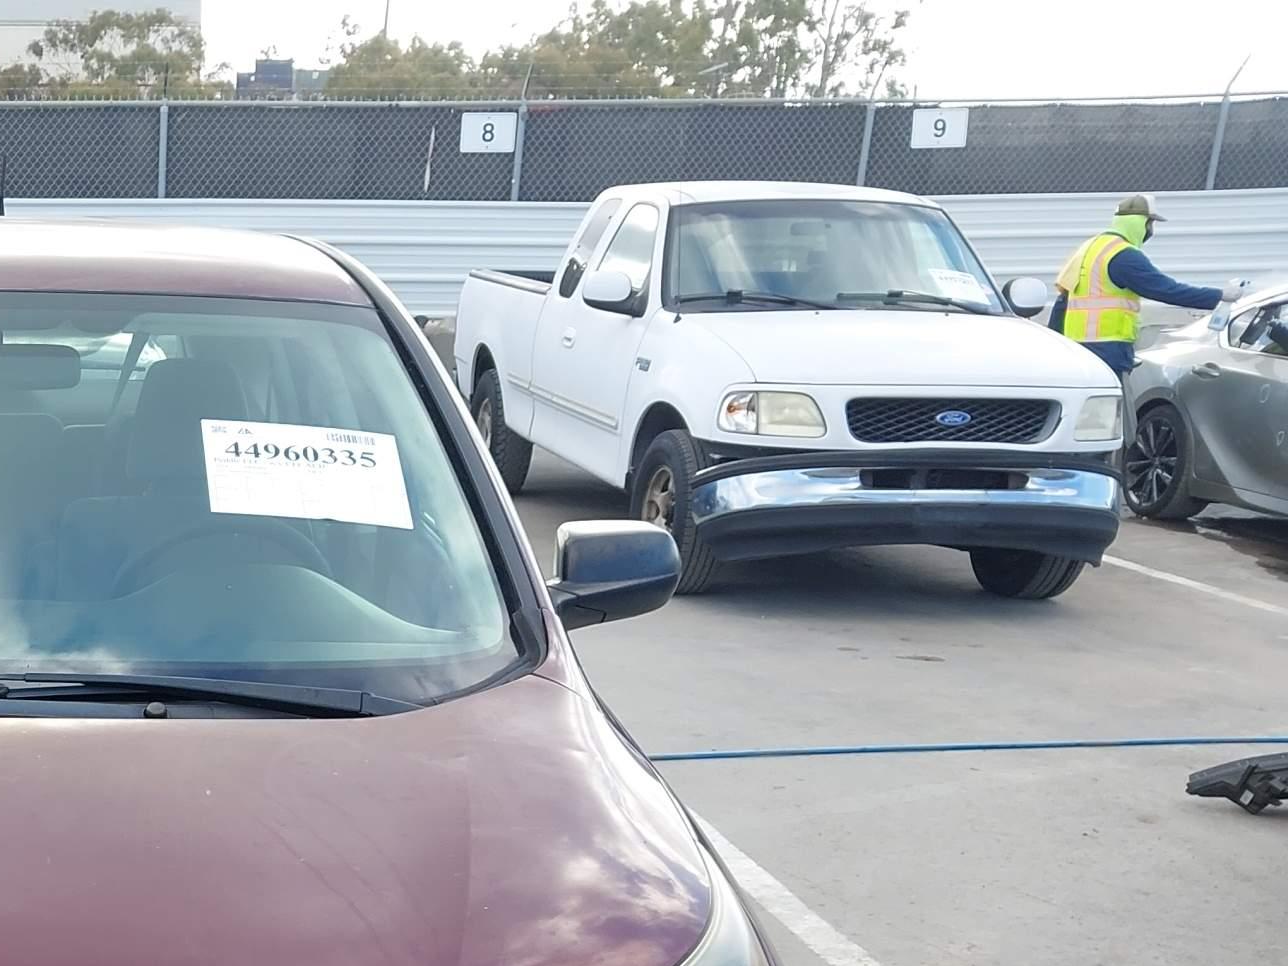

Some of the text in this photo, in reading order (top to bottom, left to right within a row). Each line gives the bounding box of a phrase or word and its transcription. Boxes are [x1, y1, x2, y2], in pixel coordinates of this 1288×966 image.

[482, 123, 495, 142] 8
[933, 119, 946, 138] 9
[225, 442, 376, 468] 44960335
